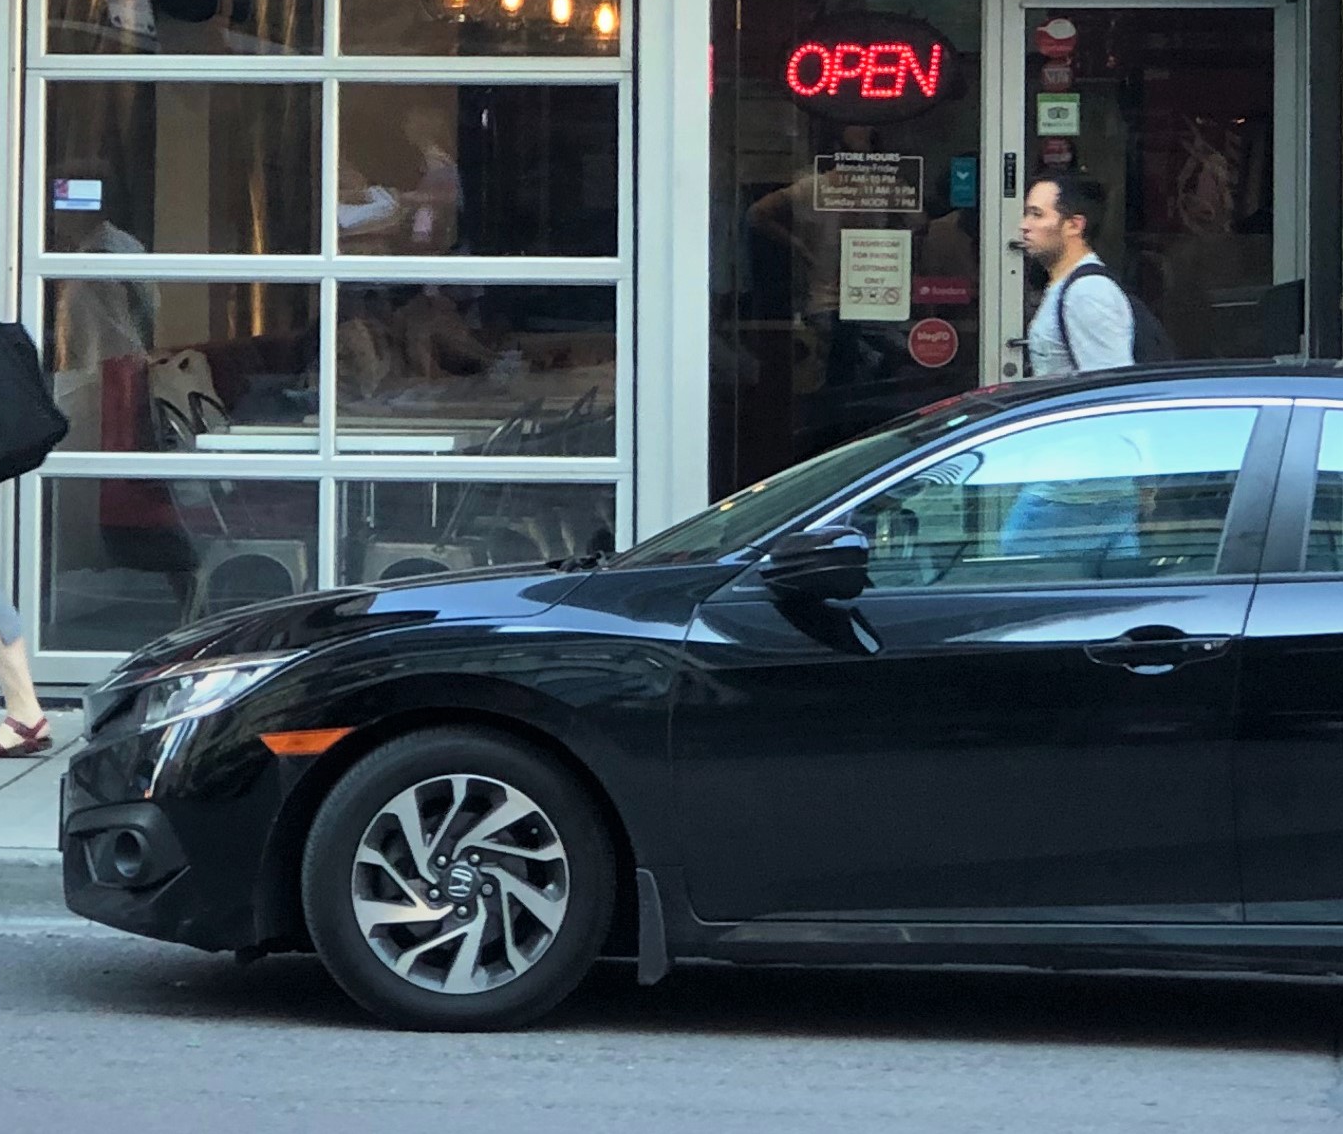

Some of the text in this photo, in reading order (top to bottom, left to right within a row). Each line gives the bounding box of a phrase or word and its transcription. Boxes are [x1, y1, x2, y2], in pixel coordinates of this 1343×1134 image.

[787, 42, 942, 99] OPEN
[834, 152, 901, 162] STORE HOURS
